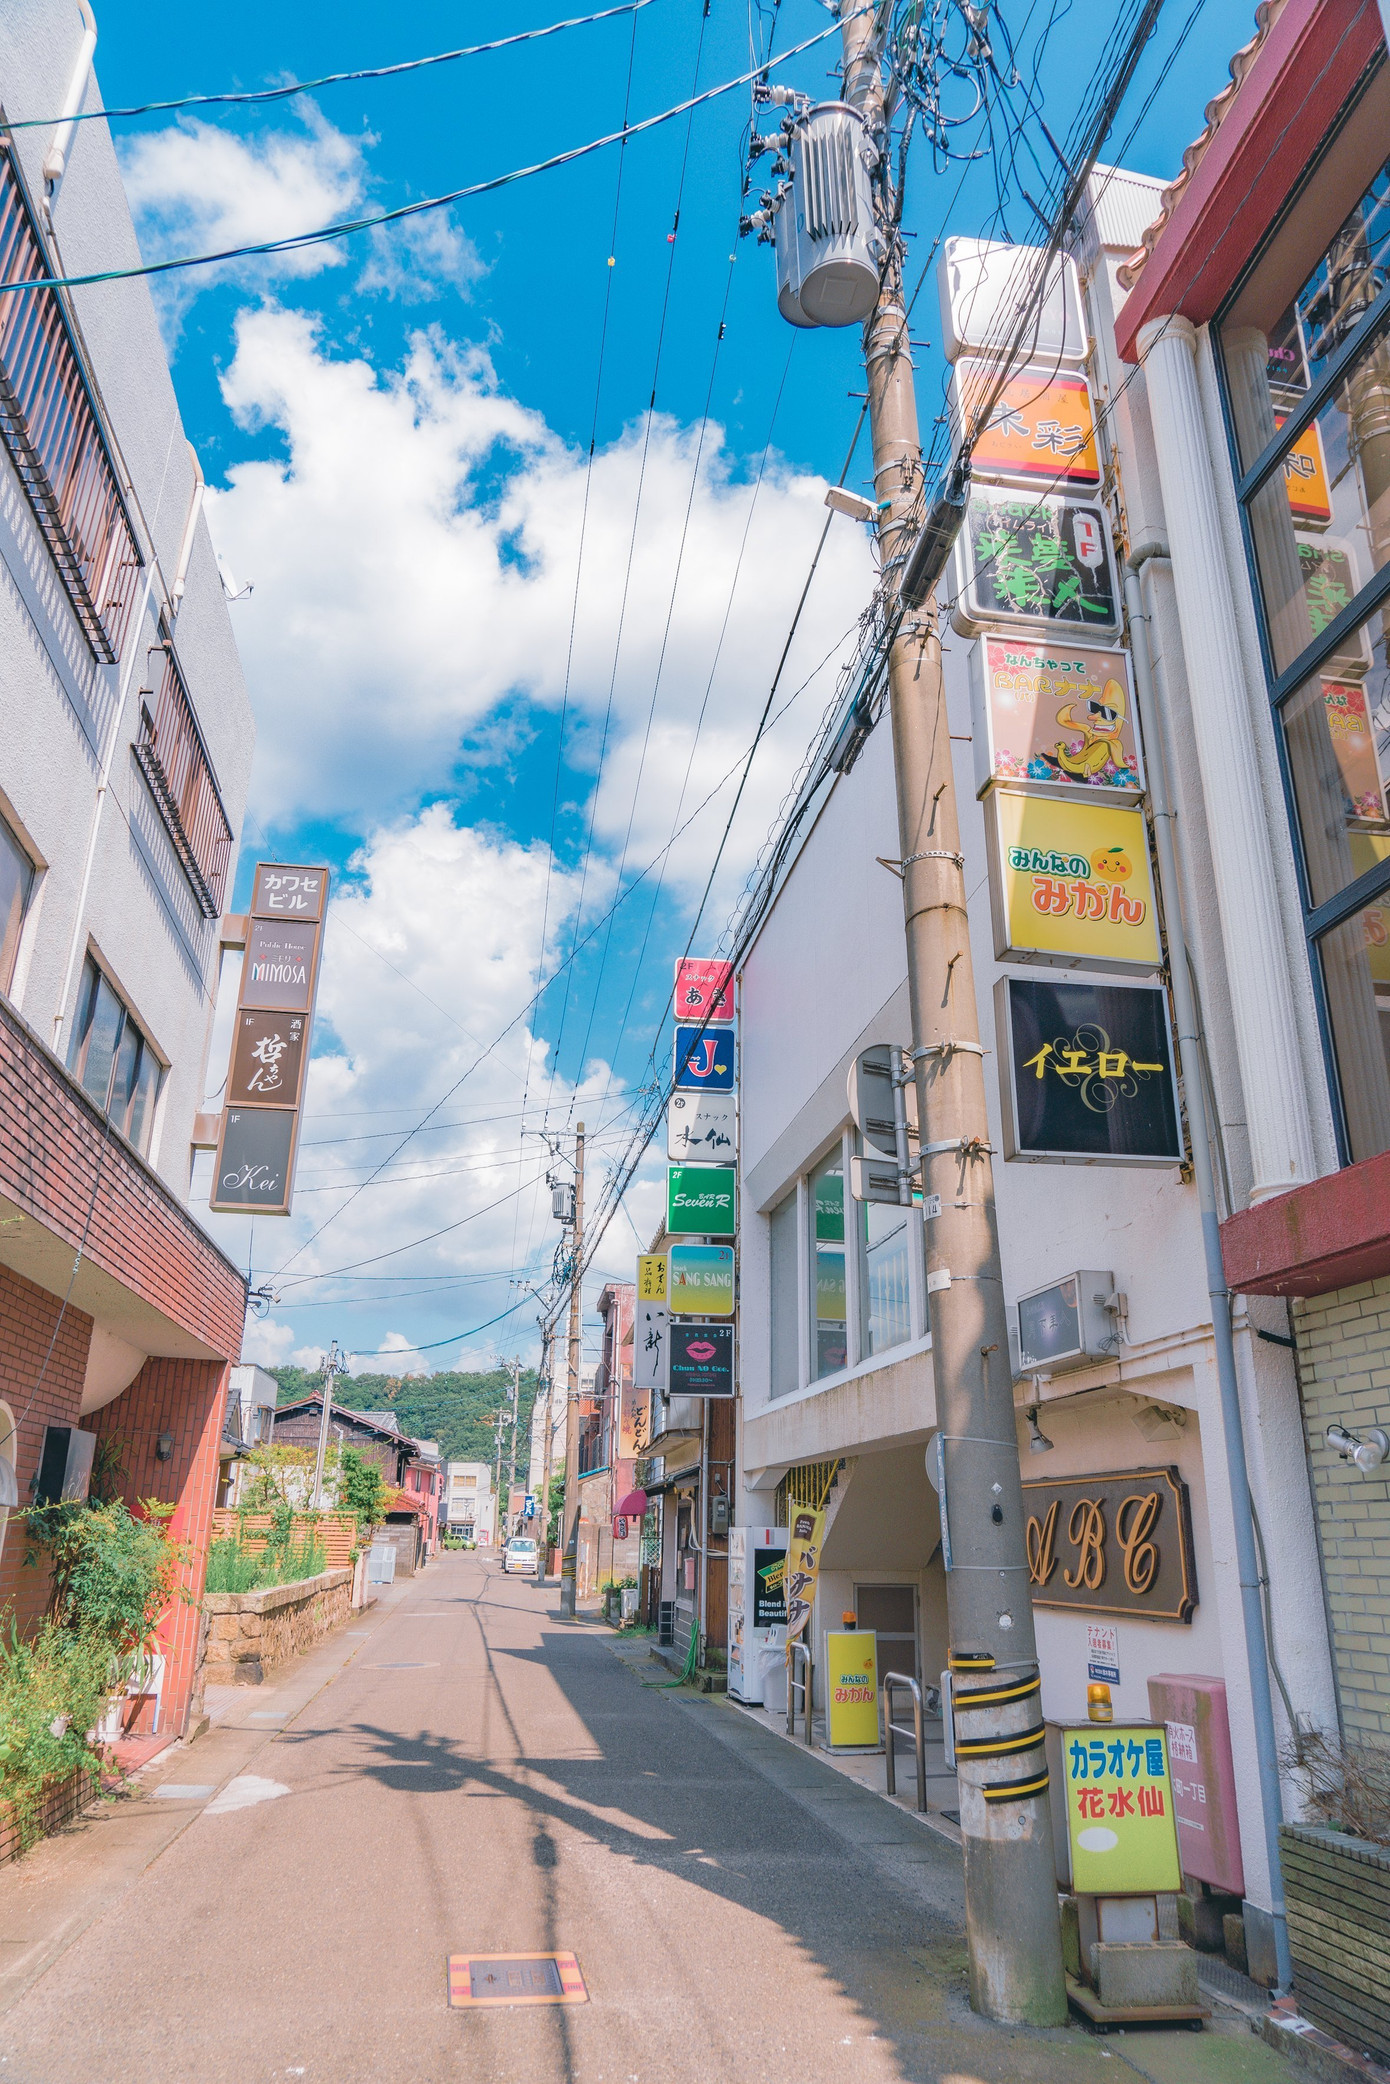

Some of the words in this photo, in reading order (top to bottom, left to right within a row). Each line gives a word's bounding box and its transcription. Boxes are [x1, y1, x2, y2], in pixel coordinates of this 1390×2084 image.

[1005, 653, 1086, 674] なんちゃって
[1010, 848, 1090, 877] みんなの
[265, 874, 319, 892] カワセ
[268, 892, 308, 910] ビル
[1032, 876, 1144, 924] みかん
[252, 962, 306, 984] MIMOSA
[290, 1019, 302, 1041] 酒家
[687, 1040, 718, 1078] J
[1022, 1043, 1164, 1079] イエロー
[231, 1115, 241, 1123] 1F
[696, 1112, 728, 1121] スナック
[674, 1125, 731, 1150] 水仙
[223, 1164, 279, 1191] Kei
[672, 1171, 683, 1179] 2F
[656, 1261, 665, 1294] おでん
[672, 1271, 701, 1286] SANG
[703, 1272, 732, 1287] SANG
[719, 1329, 732, 1337] 2F
[632, 1405, 648, 1452] どんどん
[758, 1600, 781, 1608] Blend
[1087, 1626, 1115, 1639] テナント
[840, 1674, 869, 1684] みんなの
[834, 1686, 874, 1703] みかん
[1069, 1739, 1165, 1779] カラオケ屋
[1172, 1777, 1207, 1804] 町一丁目
[1076, 1785, 1165, 1819] 花水仙
